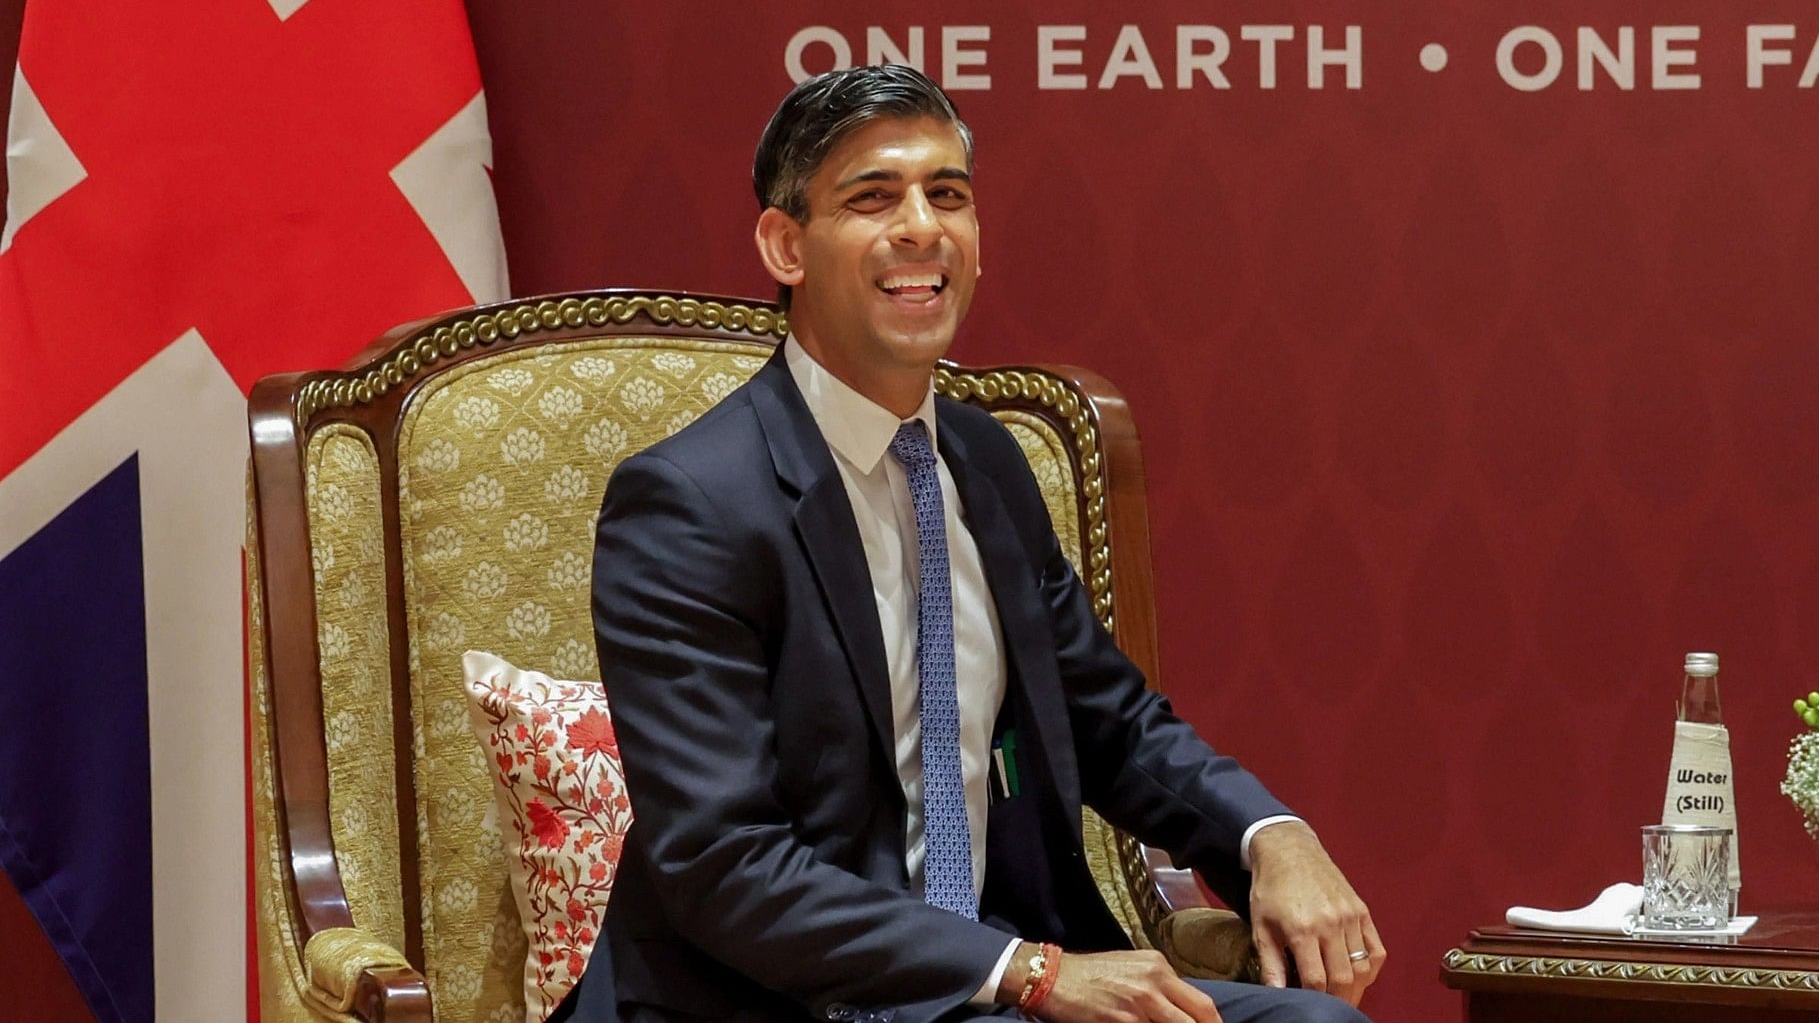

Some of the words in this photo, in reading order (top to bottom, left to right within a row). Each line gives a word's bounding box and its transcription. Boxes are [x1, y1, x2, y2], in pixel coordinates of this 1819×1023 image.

[785, 26, 992, 89] ONE
[1037, 25, 1362, 89] EARTH
[1496, 25, 1701, 91] ONE
[1677, 769, 1728, 784] Water
[1676, 795, 1725, 814] (Still)
